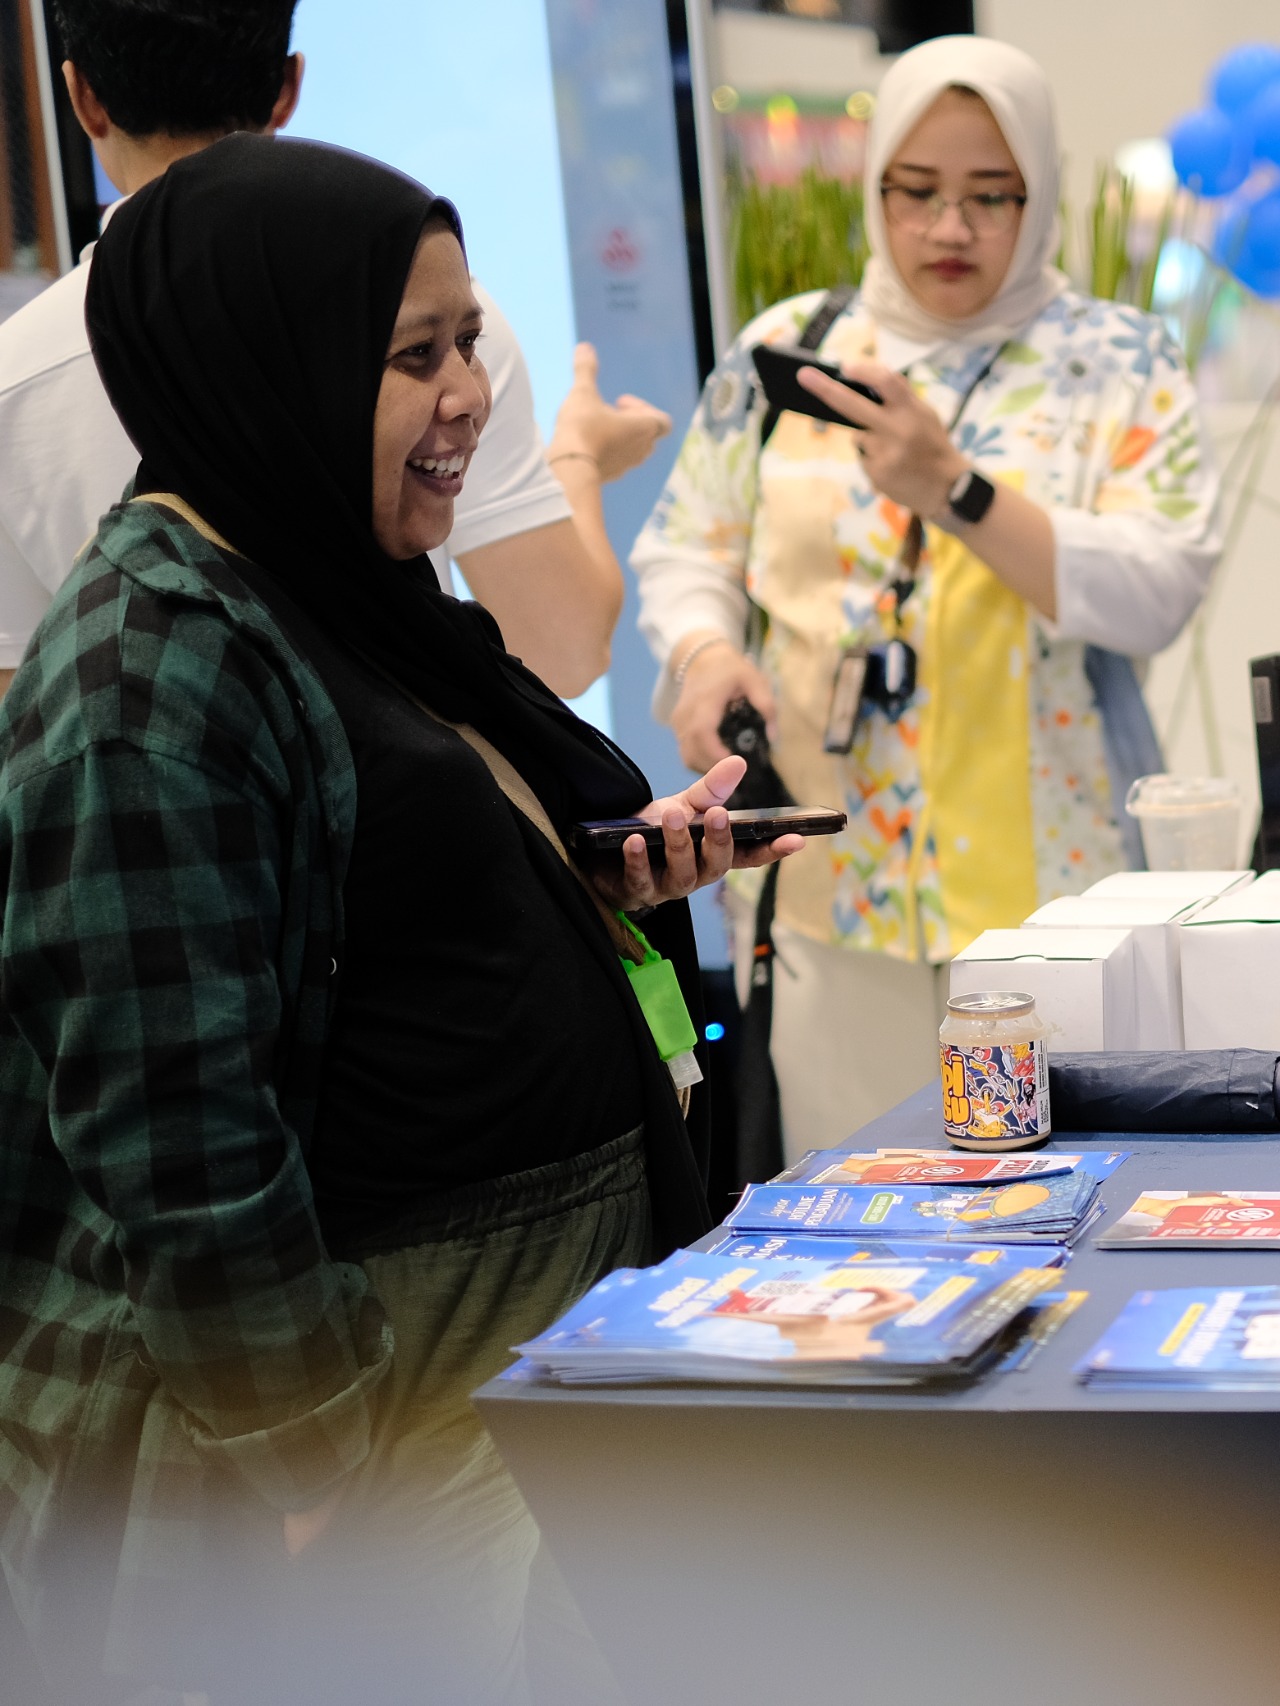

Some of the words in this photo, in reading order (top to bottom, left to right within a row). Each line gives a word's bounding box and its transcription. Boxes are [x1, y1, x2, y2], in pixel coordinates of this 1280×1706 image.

[788, 1195, 816, 1220] HOTLINE
[804, 1188, 839, 1226] PENGADUAN
[748, 1239, 788, 1260] MASI
